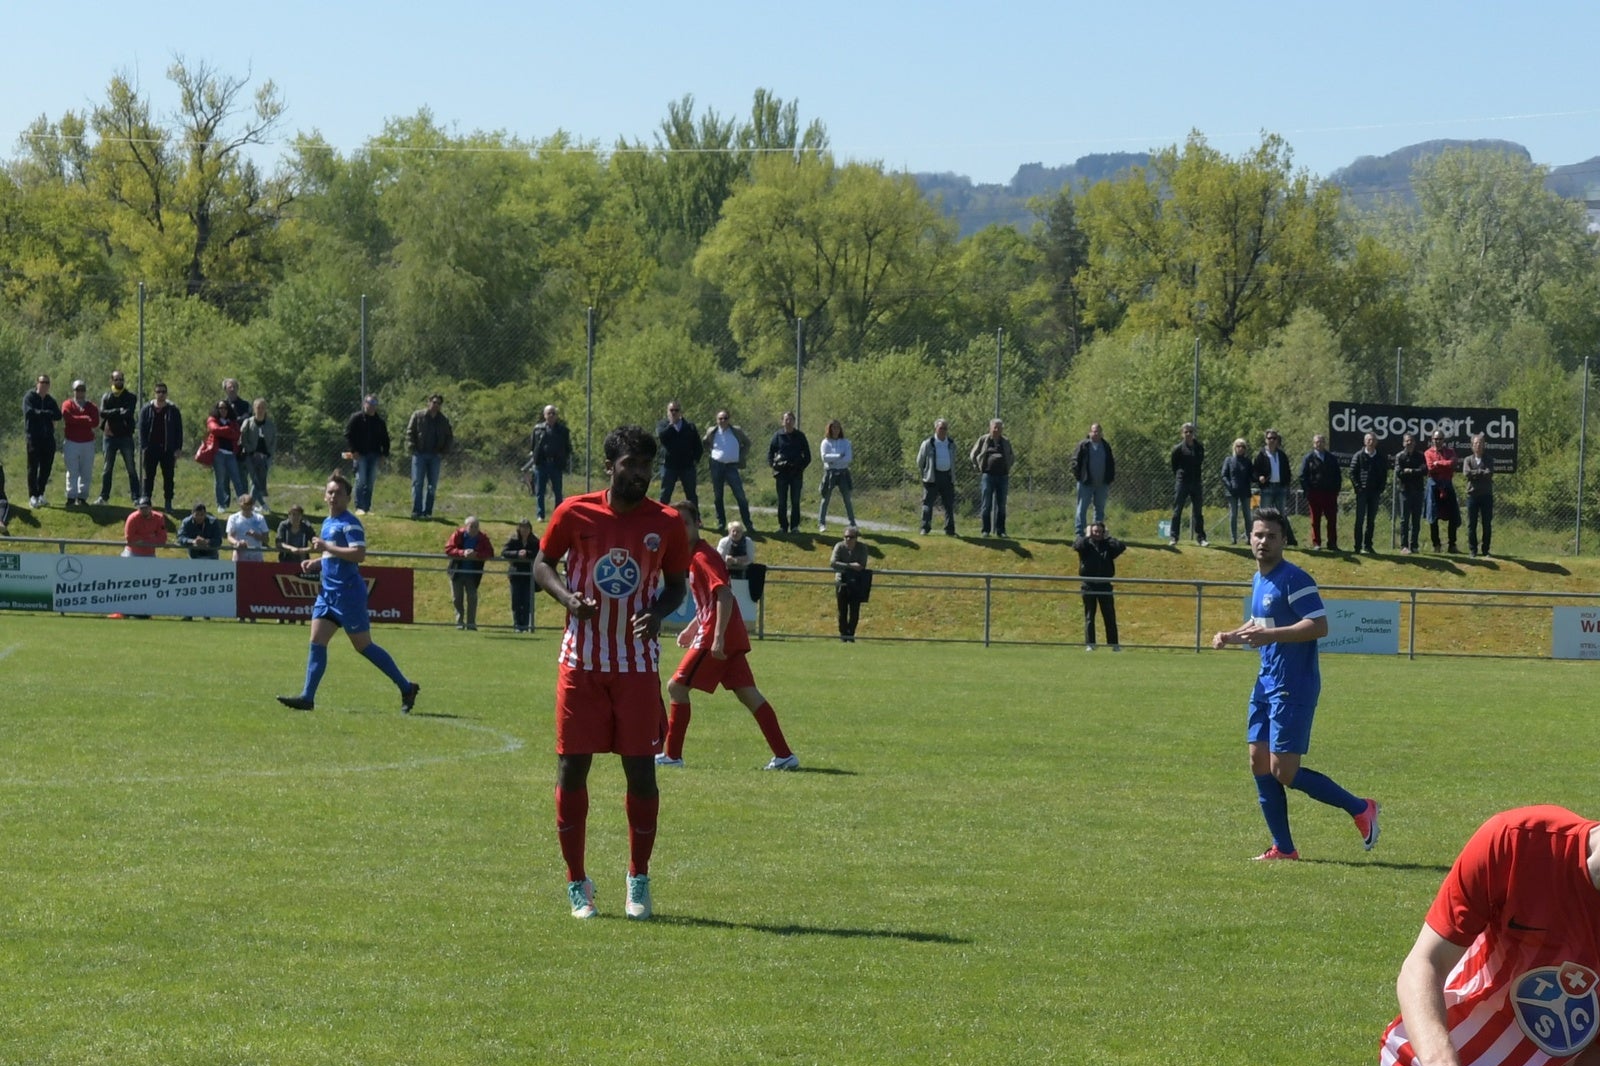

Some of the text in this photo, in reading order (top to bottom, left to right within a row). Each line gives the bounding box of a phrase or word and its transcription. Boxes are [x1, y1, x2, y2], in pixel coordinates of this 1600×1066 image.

[56, 571, 234, 594] Nutzfahrzeug-Zentrum
[56, 584, 233, 607] 8952 Schlieren 01 738 38 38
